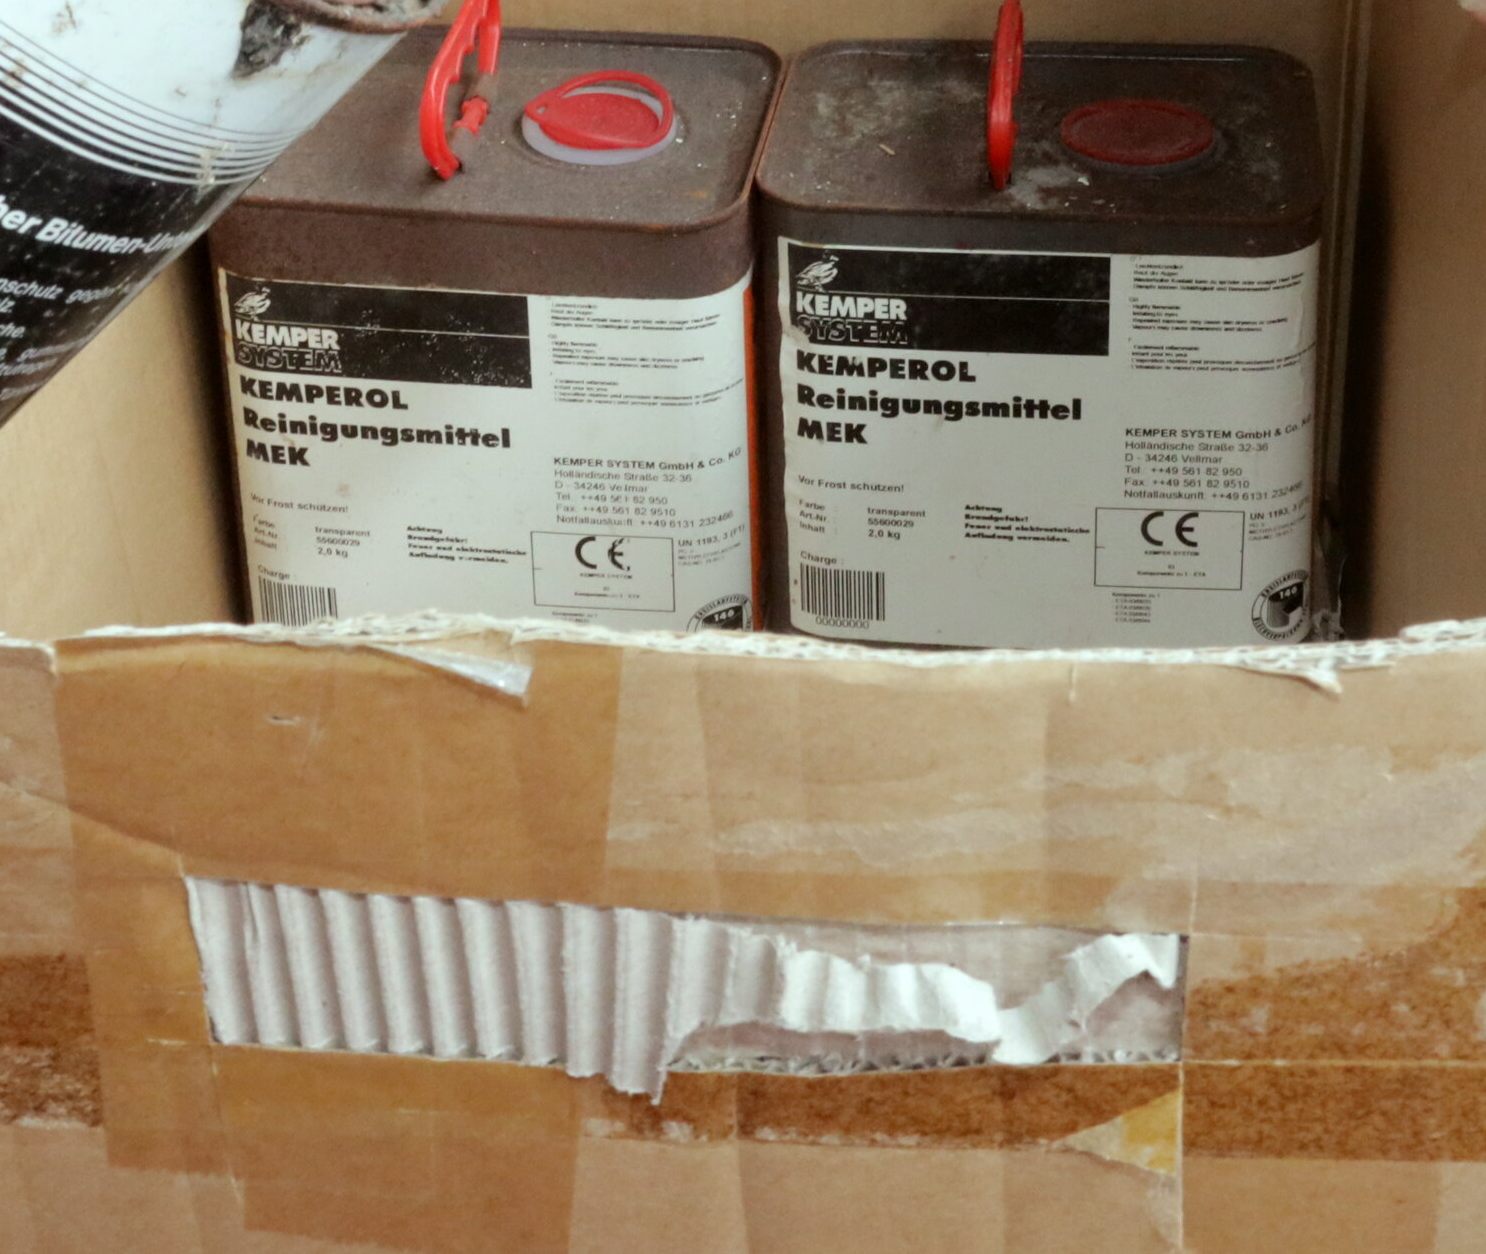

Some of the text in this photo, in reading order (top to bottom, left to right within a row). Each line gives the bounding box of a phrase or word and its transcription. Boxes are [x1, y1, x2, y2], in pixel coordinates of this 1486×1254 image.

[796, 291, 907, 320] KEMPER
[235, 318, 340, 350] KEMPER
[796, 314, 908, 345] SYSTEM
[237, 341, 343, 373] SYSTEM
[797, 350, 976, 382] KEMPEROL
[240, 374, 409, 410] KEMPEROL
[797, 383, 1082, 421] Reinigungsmittel
[243, 407, 511, 449] Reinigungsmittel
[797, 417, 868, 444] MEK
[1126, 427, 1177, 438] KEMPER
[1181, 429, 1231, 439] SYSTEM
[1235, 429, 1271, 439] GmbH
[1198, 442, 1234, 452] Straße
[1239, 443, 1269, 452] 32-36
[246, 439, 310, 467] MEK
[1125, 453, 1223, 464] D 34246 Vellmar
[554, 457, 603, 467] KEMPER
[607, 459, 655, 469] SYSTEM
[659, 461, 694, 470] GmbH
[697, 461, 705, 469] &
[624, 472, 659, 482] Straße
[1182, 467, 1242, 476] 561 82 950
[555, 481, 605, 491] D 34246
[798, 475, 846, 490] Vor Frost
[1183, 479, 1250, 489] 561 82 9510
[633, 496, 668, 505] 82 950
[1241, 491, 1268, 501] 6131
[612, 506, 675, 517] 561 82 9510
[867, 507, 926, 518] transparent
[1250, 512, 1264, 521] UN
[670, 519, 694, 528] 6131
[315, 526, 371, 537] transparent
[868, 529, 901, 540] 2,0 kg
[677, 538, 692, 547] UN
[335, 549, 349, 559] kg
